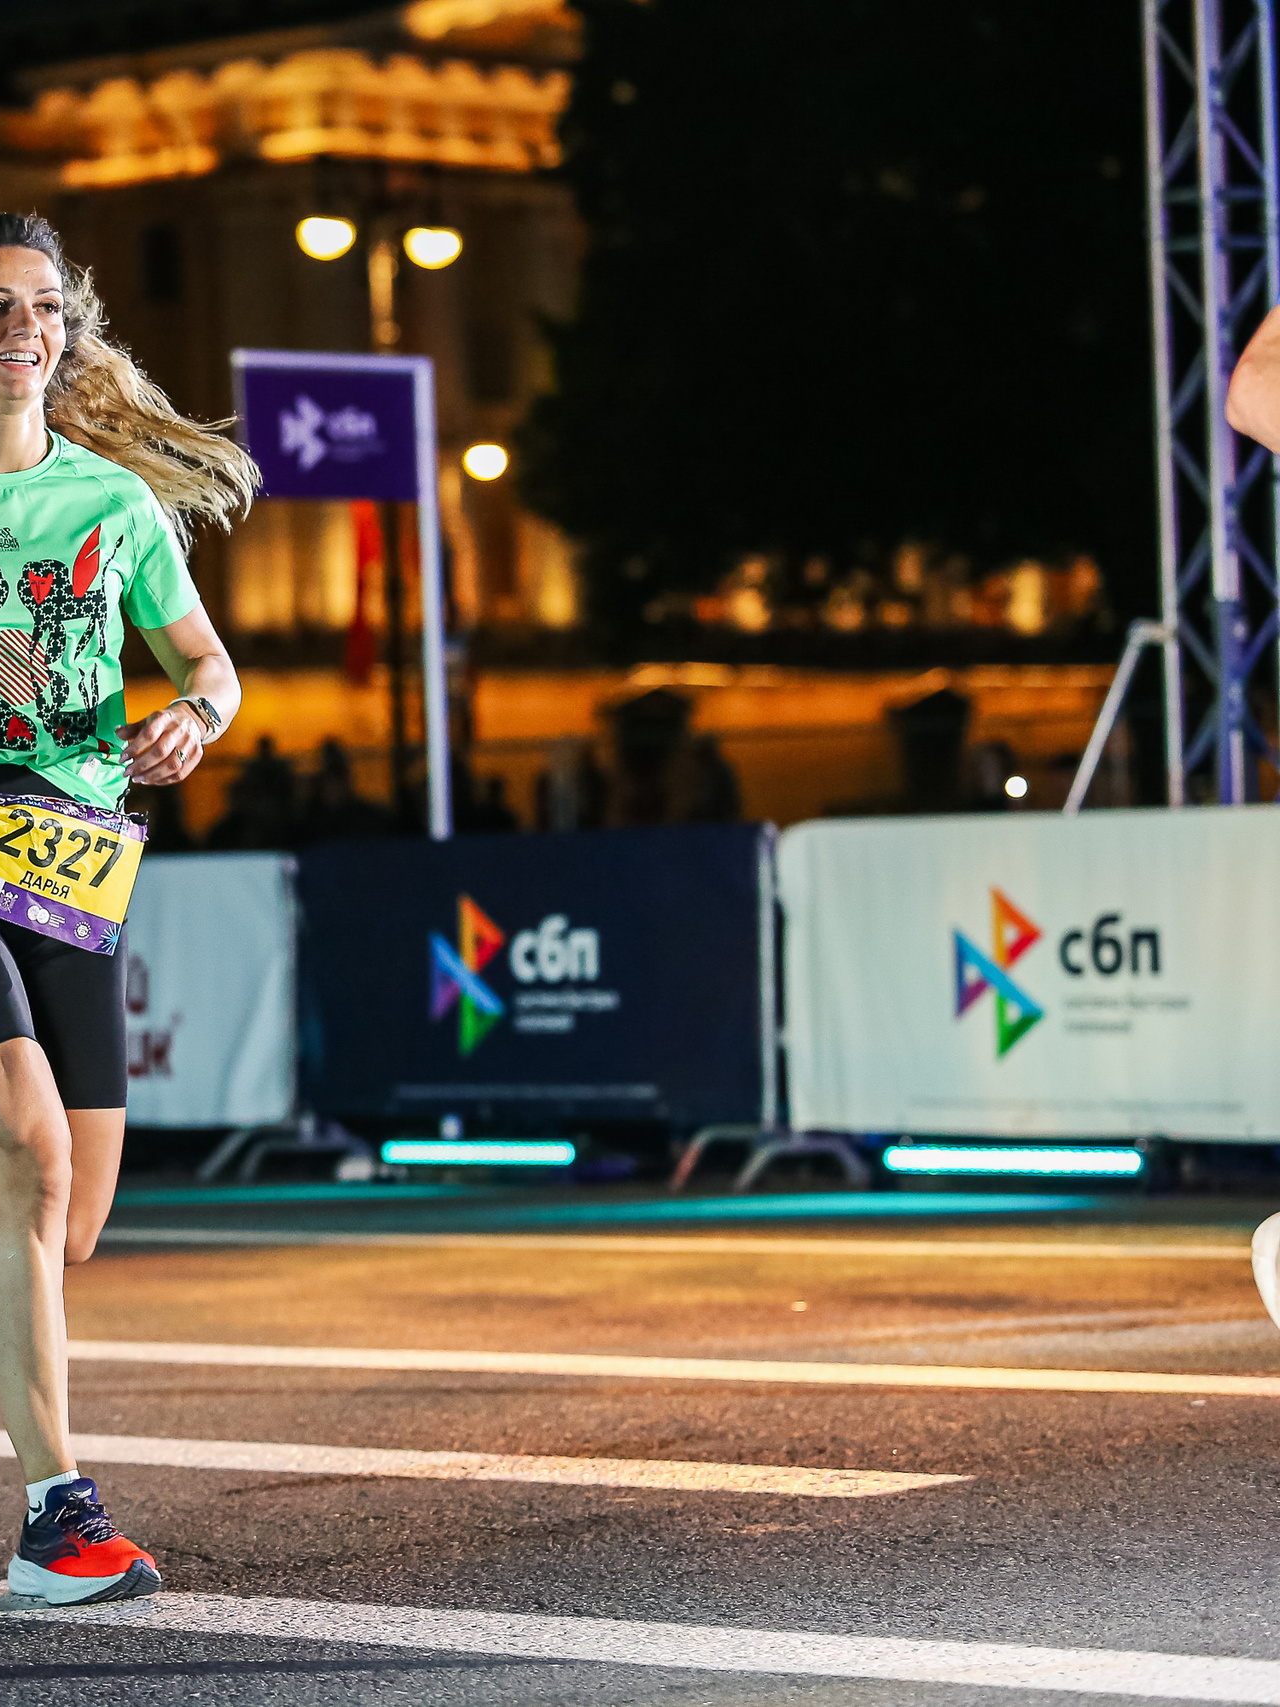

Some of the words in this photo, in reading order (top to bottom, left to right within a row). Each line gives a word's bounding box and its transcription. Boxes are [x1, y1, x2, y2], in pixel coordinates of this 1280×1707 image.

[19, 871, 70, 899] ДАРЬЯ
[509, 913, 599, 983] сбп
[1058, 910, 1162, 977] сбп
